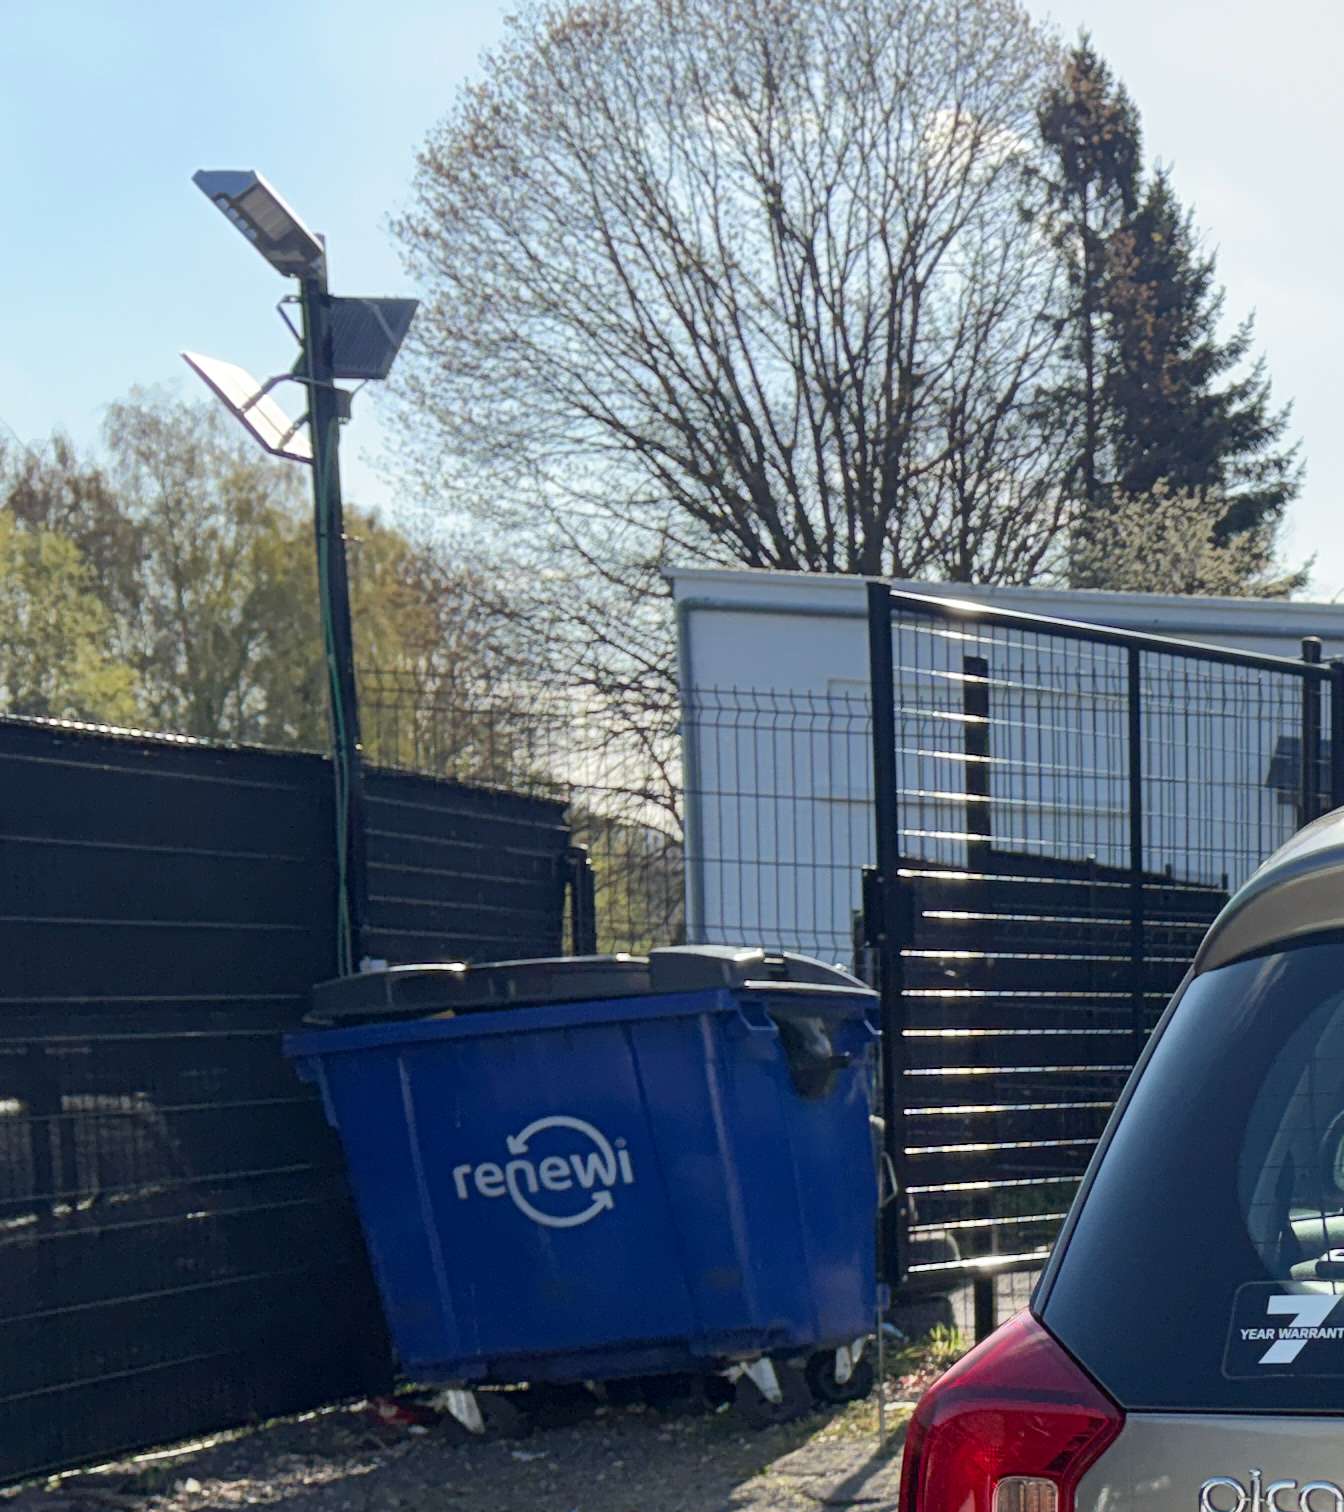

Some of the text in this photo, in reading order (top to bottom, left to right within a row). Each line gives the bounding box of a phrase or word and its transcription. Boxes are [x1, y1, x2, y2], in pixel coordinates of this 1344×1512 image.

[452, 1136, 634, 1200] renewi
[1240, 1328, 1275, 1341] YEAR
[1258, 1294, 1344, 1364] 7
